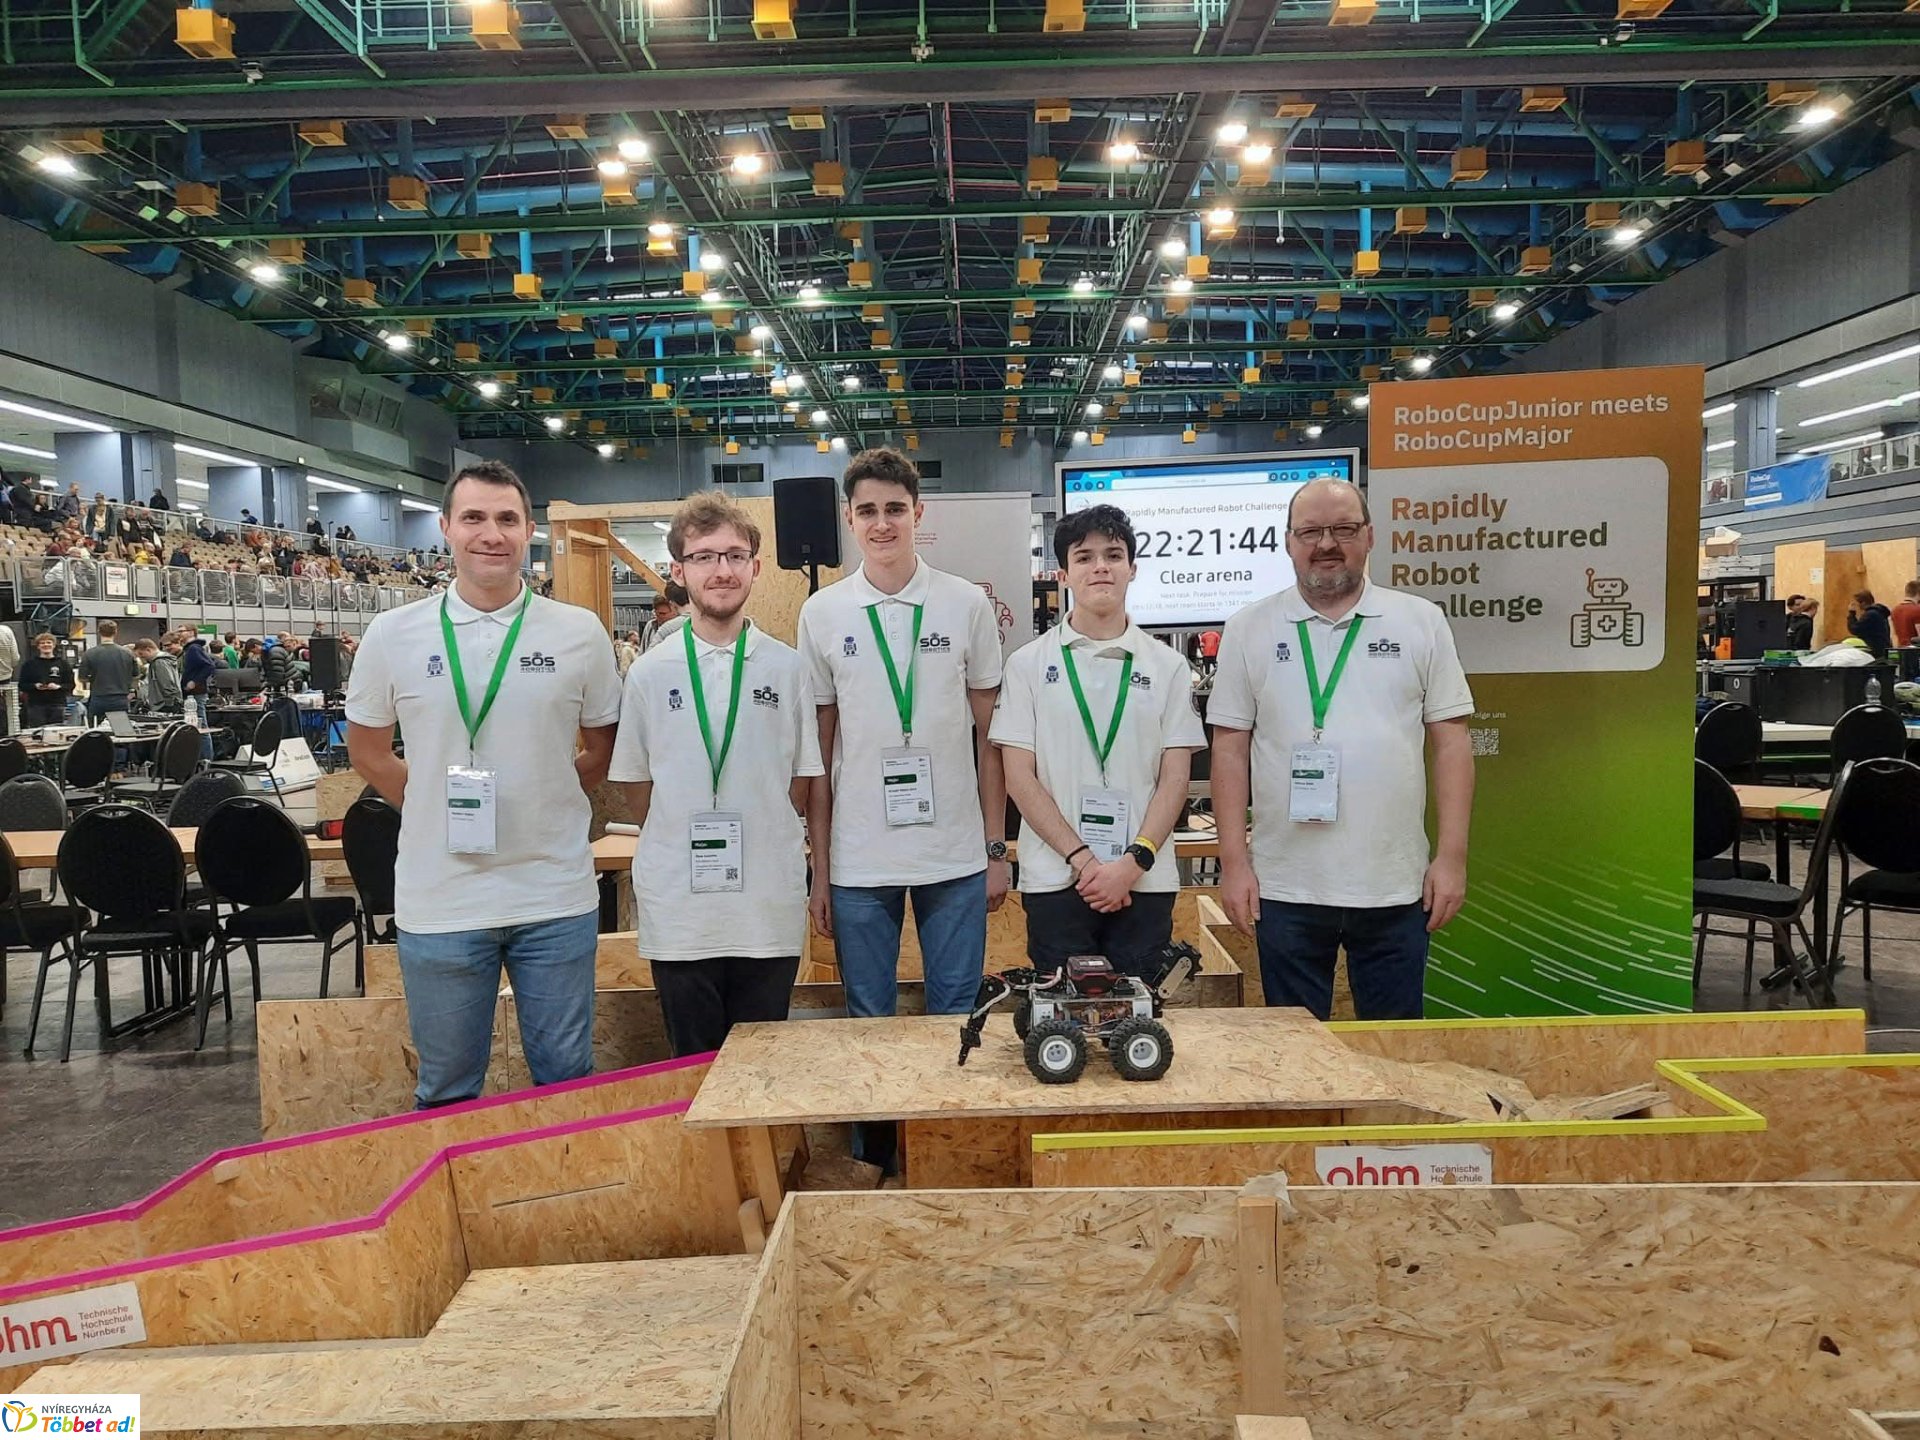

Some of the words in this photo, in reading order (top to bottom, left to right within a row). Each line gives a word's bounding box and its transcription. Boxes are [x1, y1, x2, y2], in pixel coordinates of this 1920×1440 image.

[1394, 397, 1583, 425] RoboCupJunior
[1591, 394, 1669, 416] meets
[1394, 425, 1573, 451] RoboCupMajor
[1126, 508, 1156, 518] Rapidly
[1158, 504, 1216, 515] Manufactured
[1218, 503, 1244, 512] Robot
[1245, 502, 1288, 513] Challenge
[1392, 493, 1508, 525] Rapidly
[1135, 526, 1279, 559] 22:21:44
[1392, 522, 1608, 554] Manufactured
[1160, 571, 1202, 585] Clear
[1206, 570, 1253, 582] arena
[1392, 562, 1480, 587] Robot
[920, 637, 951, 648] SOS
[1368, 643, 1401, 652] SOS
[520, 657, 555, 666] SOS
[1130, 676, 1151, 685] OS
[753, 689, 779, 703] SOS
[1430, 1163, 1480, 1174] Technische
[78, 1305, 129, 1321] Technische
[81, 1313, 134, 1330] Hochschule
[0, 1316, 77, 1353] hm
[82, 1325, 126, 1340] Nürnberg
